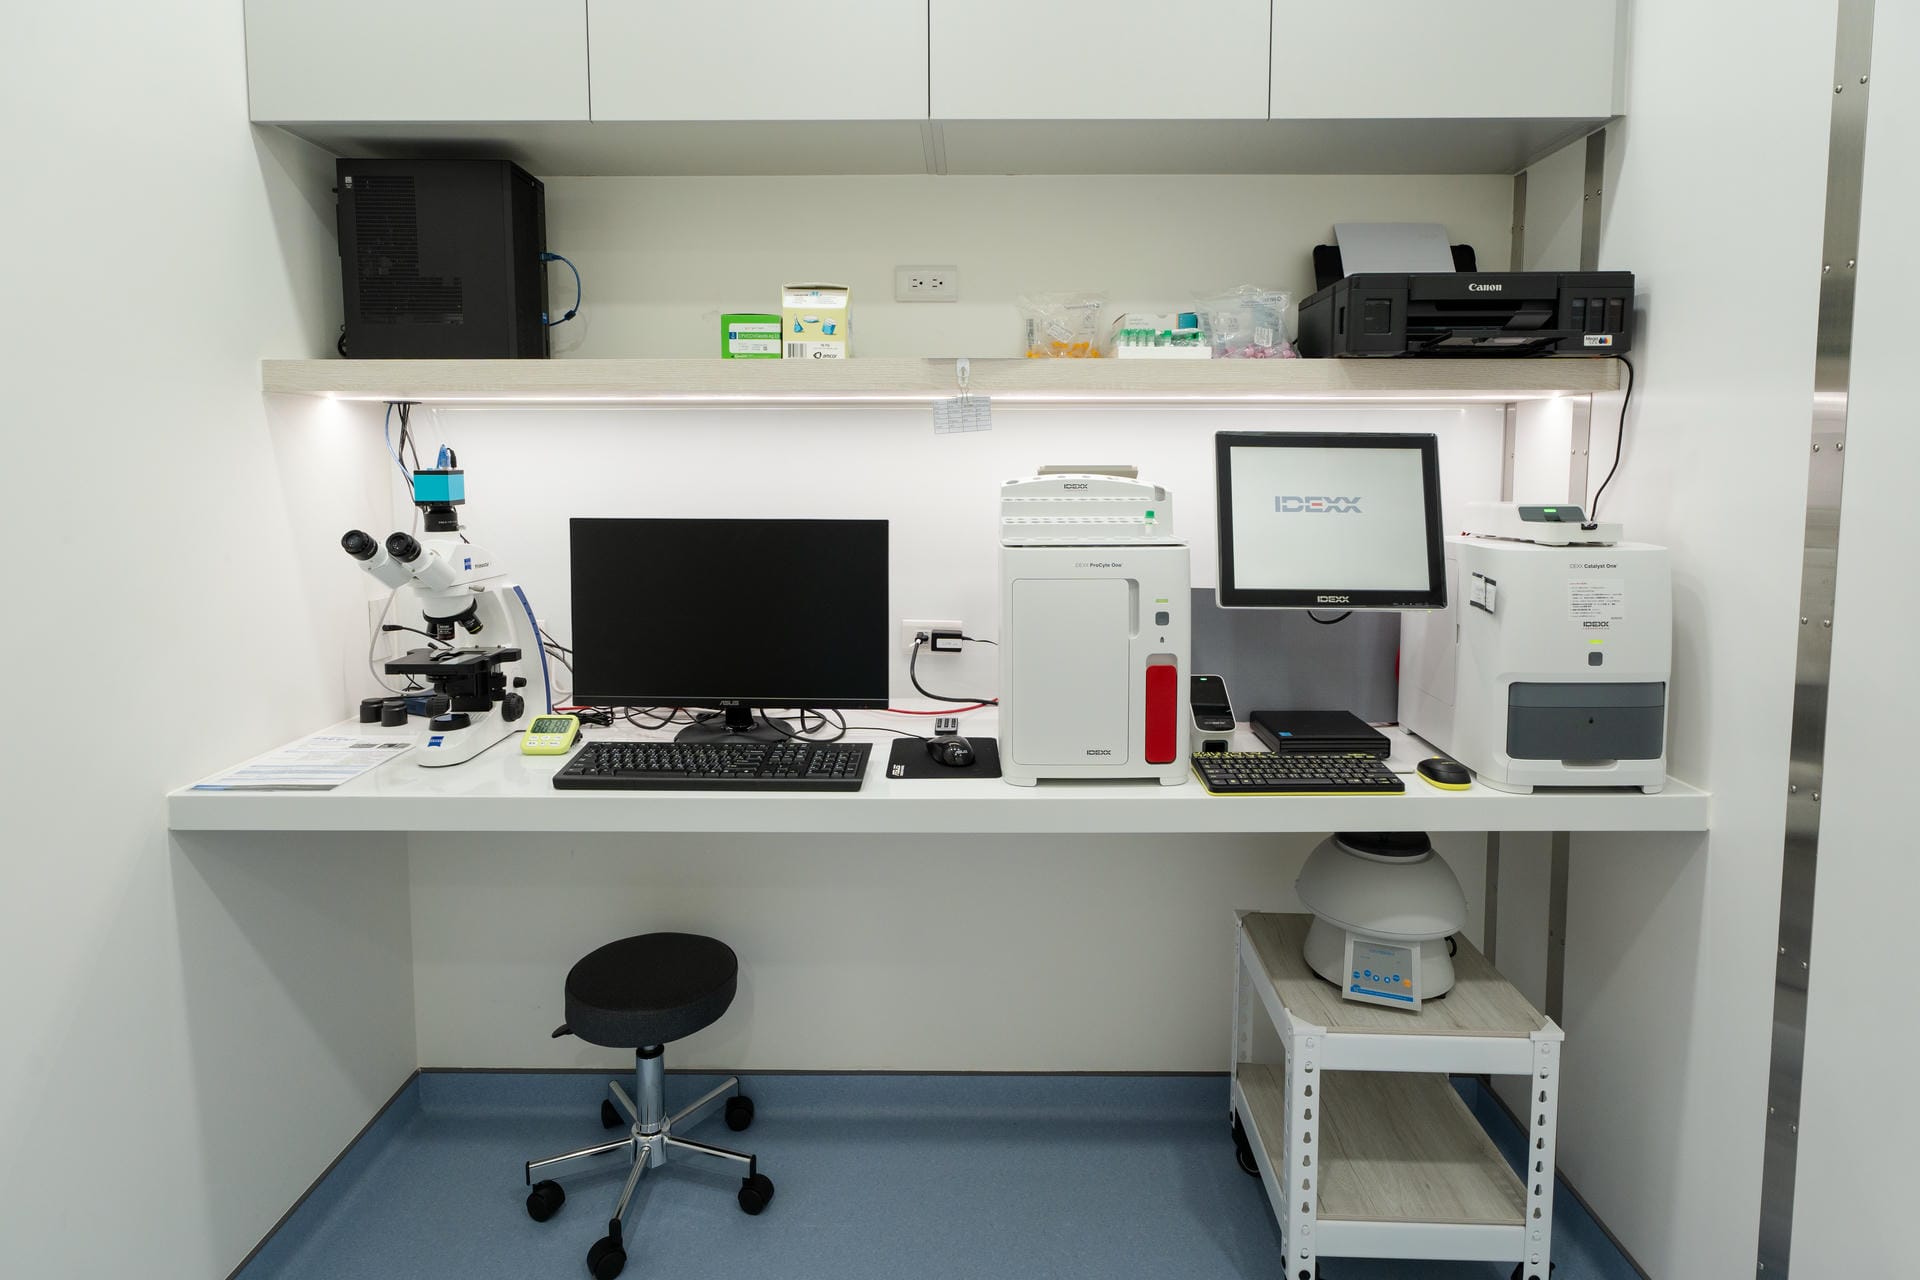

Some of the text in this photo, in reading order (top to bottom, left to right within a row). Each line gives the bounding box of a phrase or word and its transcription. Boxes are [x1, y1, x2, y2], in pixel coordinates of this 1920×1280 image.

[1468, 283, 1502, 292] Canon
[1274, 495, 1363, 514] IDEXX
[1316, 595, 1350, 603] IDEXX
